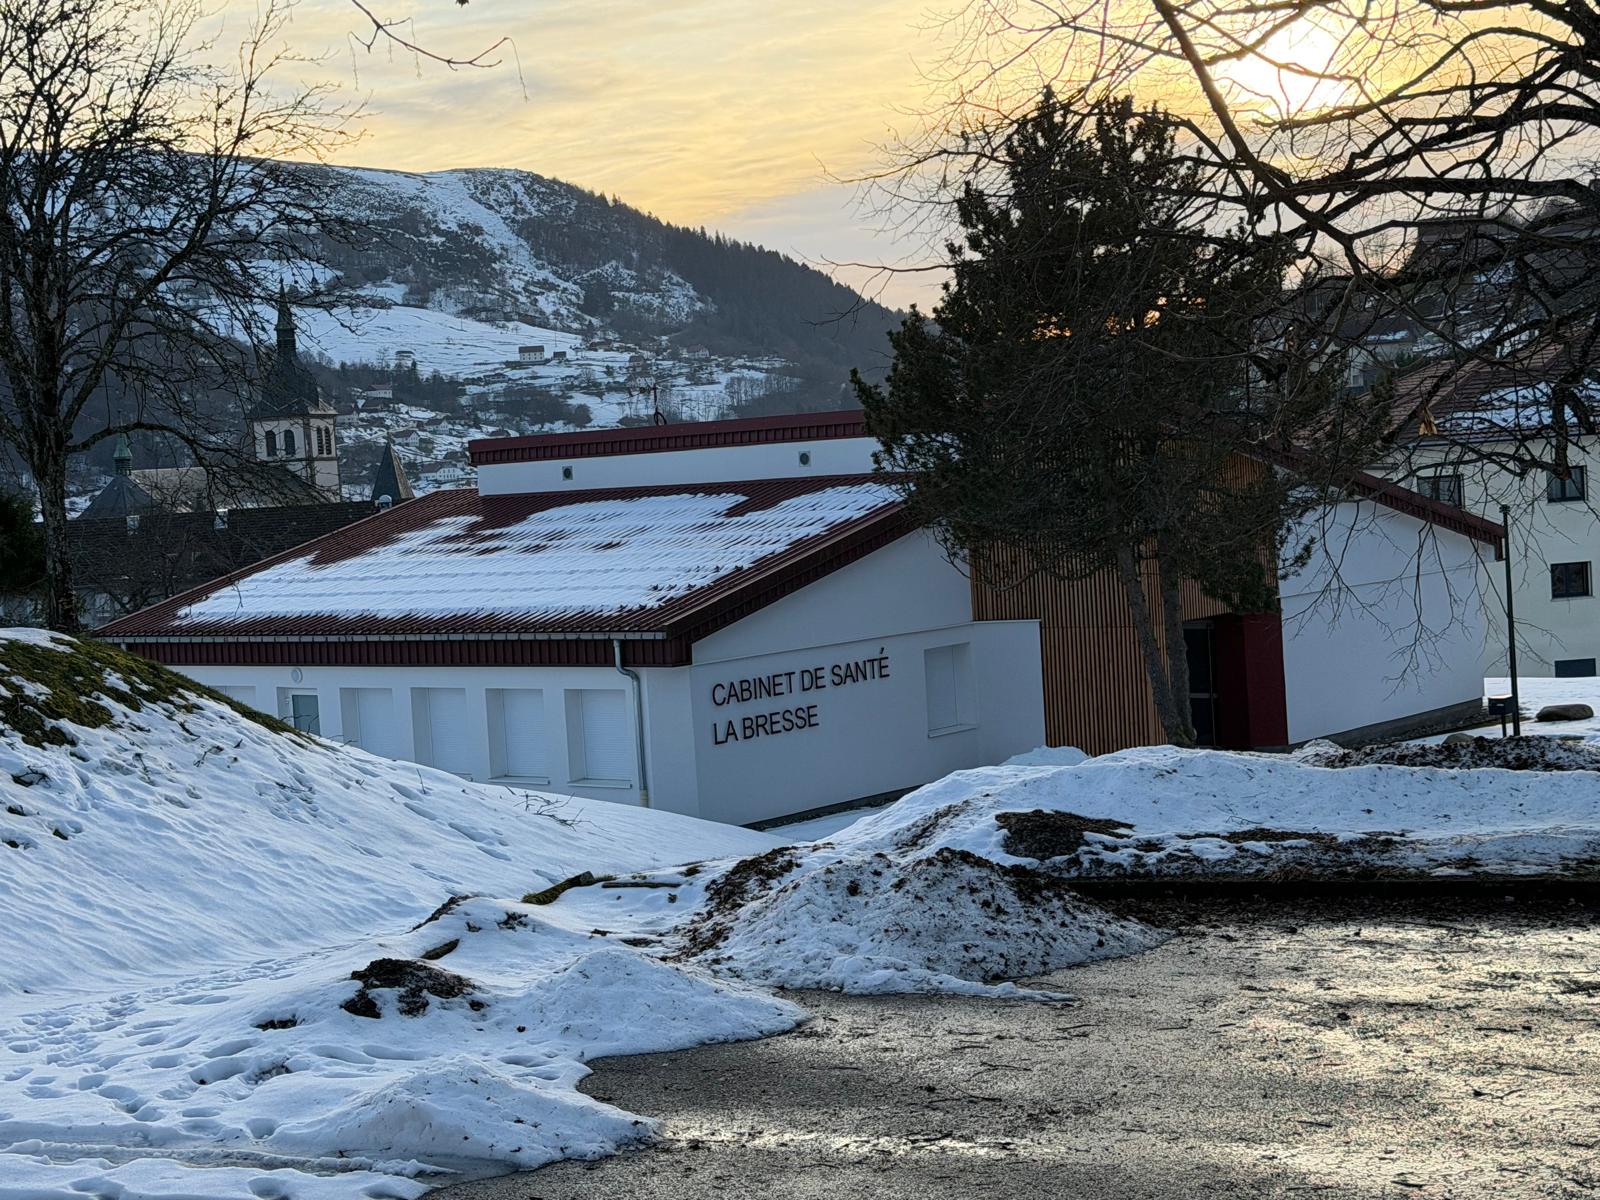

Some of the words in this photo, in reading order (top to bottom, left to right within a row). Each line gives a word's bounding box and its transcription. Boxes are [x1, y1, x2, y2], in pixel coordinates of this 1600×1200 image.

[712, 671, 796, 707] CABINET
[800, 667, 826, 692] DE
[831, 647, 890, 687] SANTÉ
[713, 720, 739, 746] LA
[742, 705, 820, 740] BRESSE
